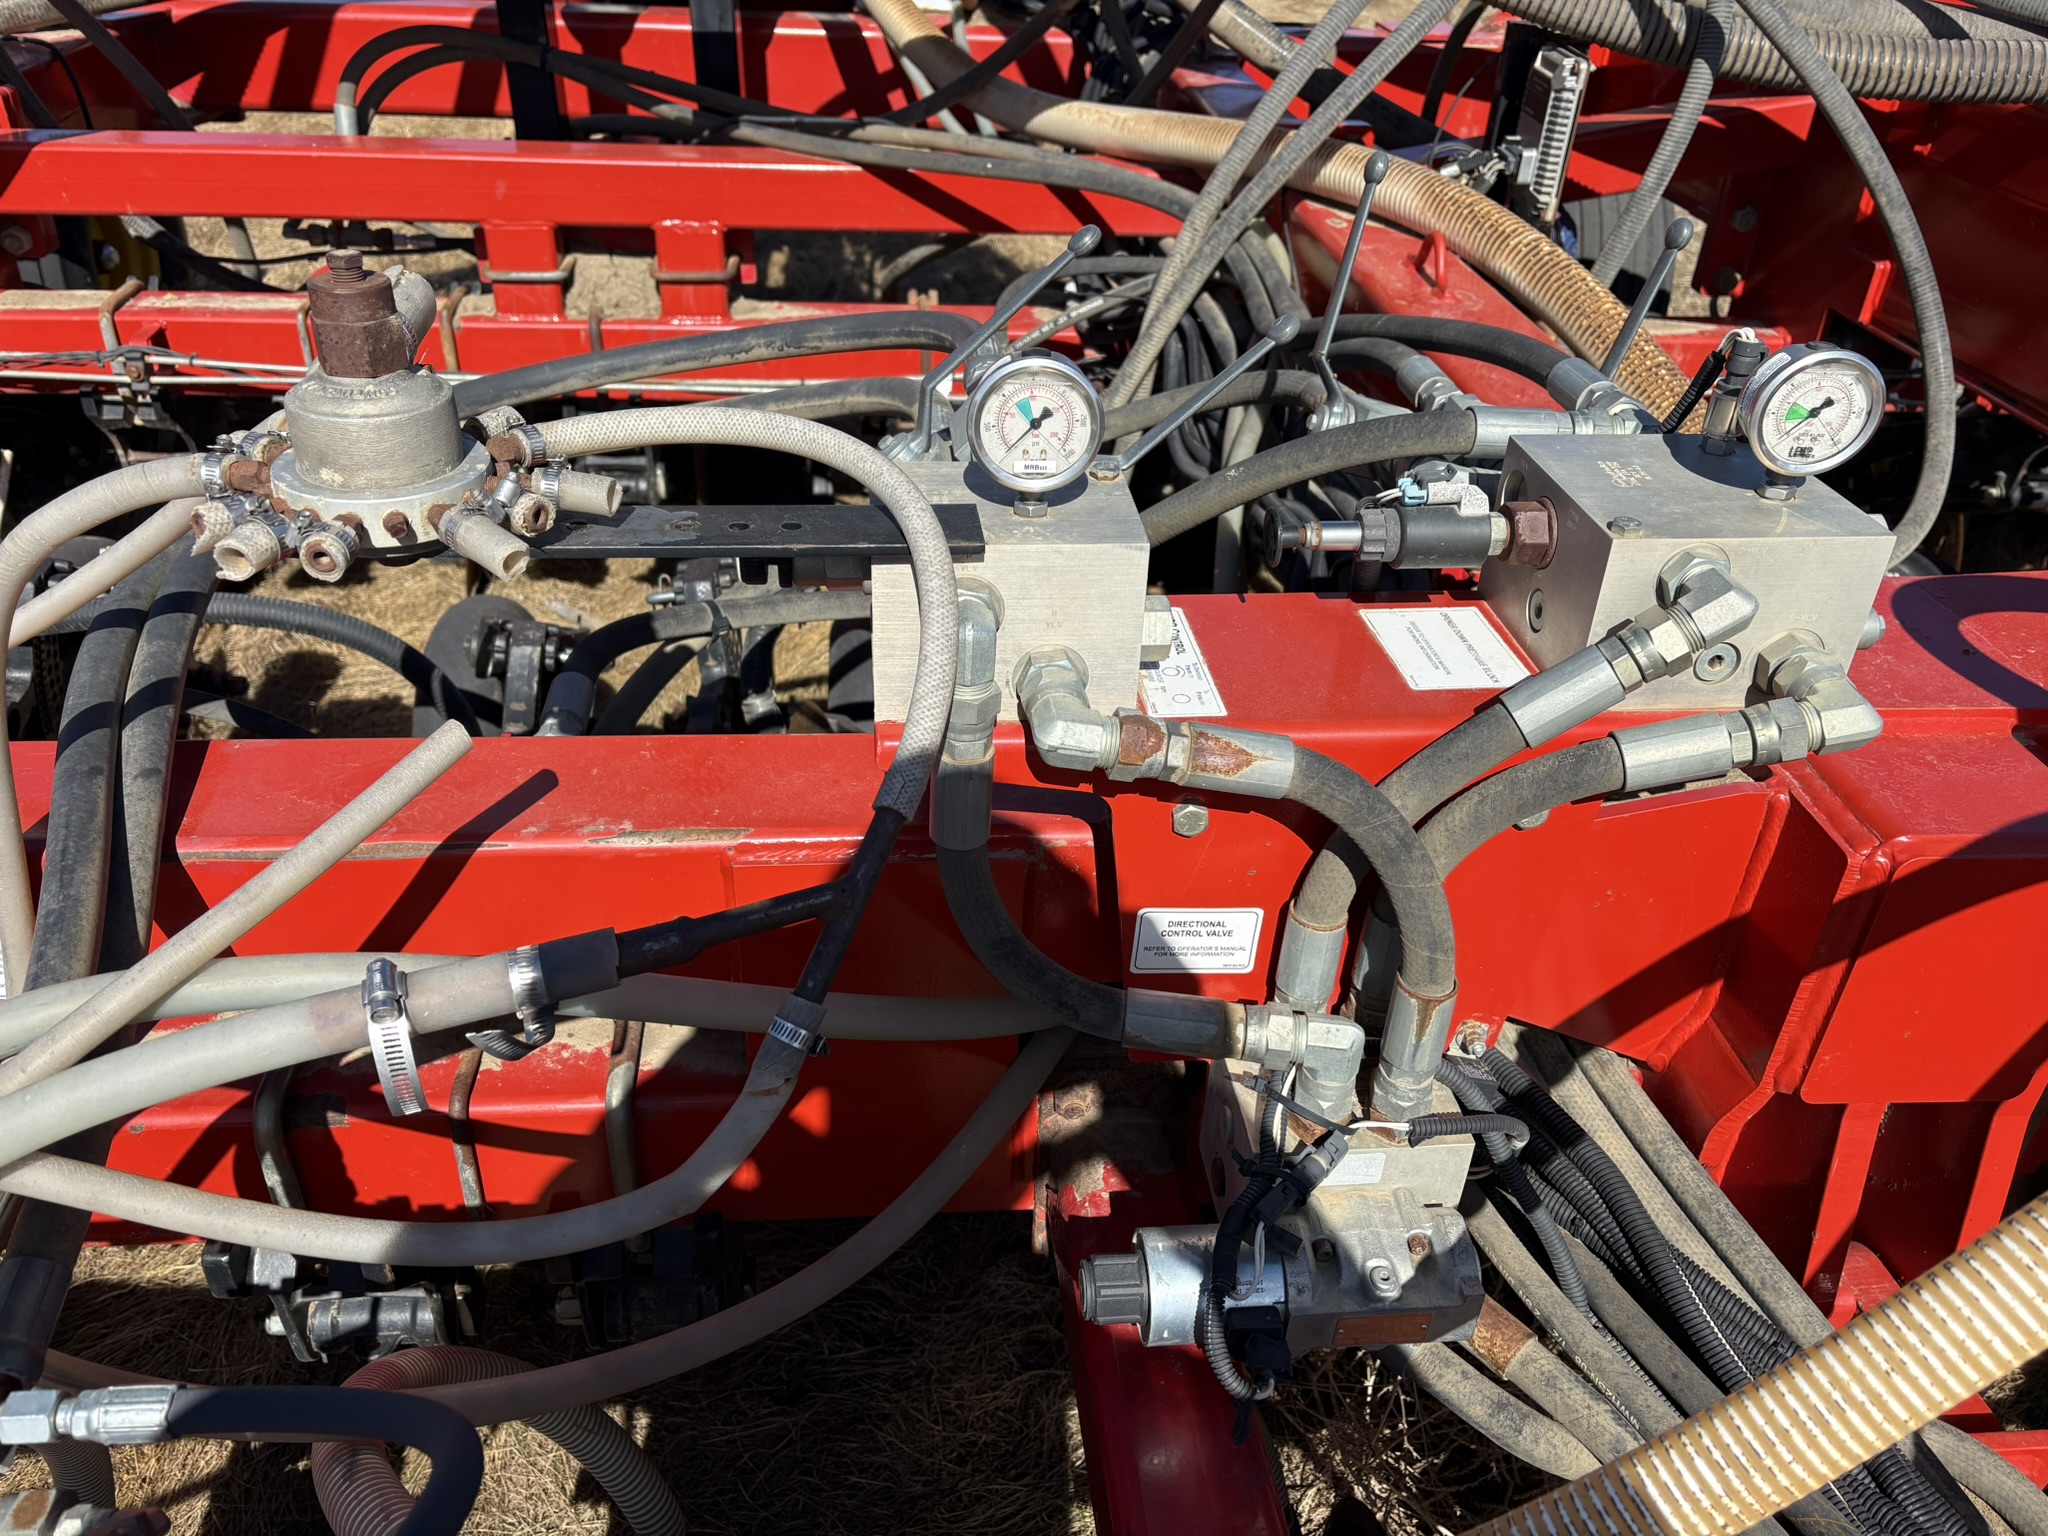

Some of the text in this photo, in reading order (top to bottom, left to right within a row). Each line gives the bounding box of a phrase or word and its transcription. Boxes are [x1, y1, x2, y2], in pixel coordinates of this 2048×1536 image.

[1167, 920, 1228, 929] DIRECTIONAL
[1160, 929, 1234, 938] CONTROL VALVE
